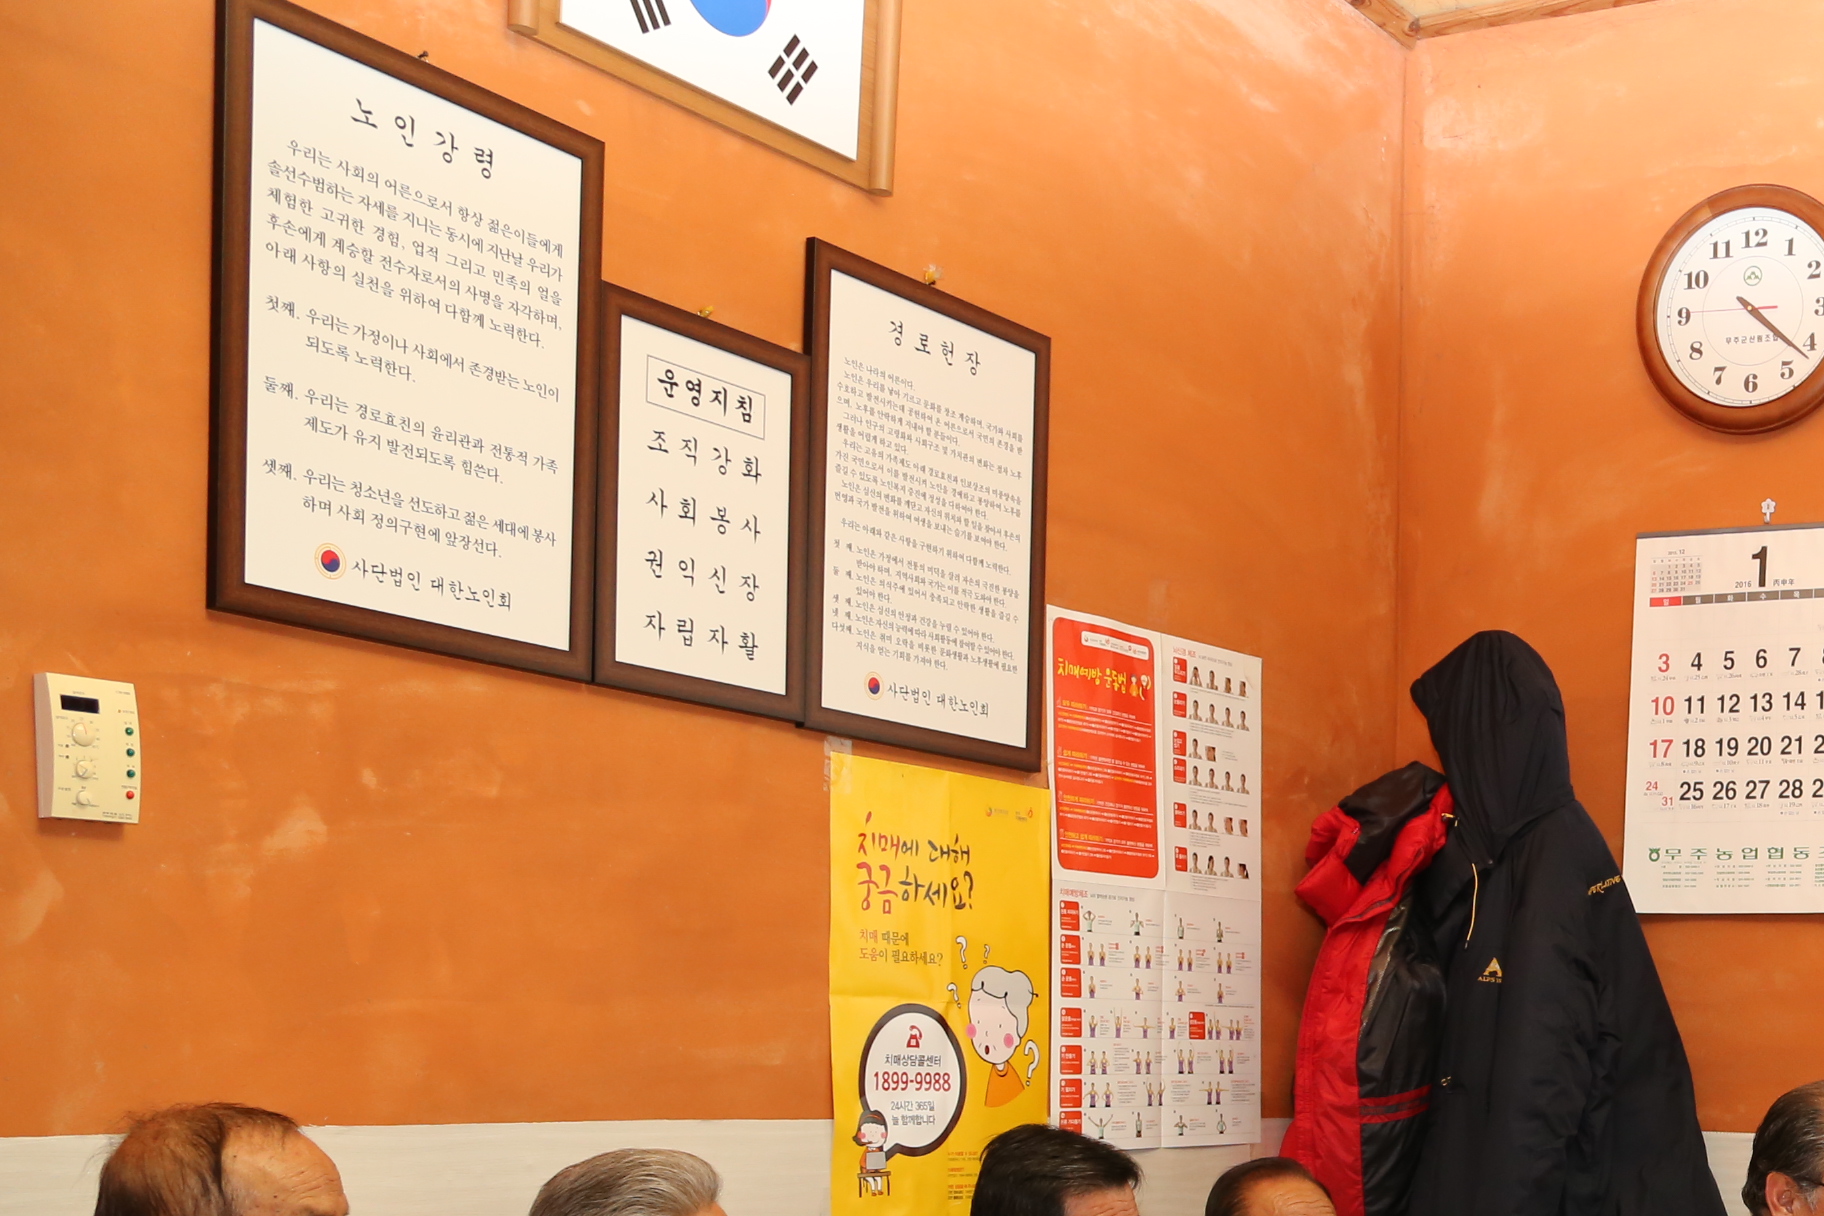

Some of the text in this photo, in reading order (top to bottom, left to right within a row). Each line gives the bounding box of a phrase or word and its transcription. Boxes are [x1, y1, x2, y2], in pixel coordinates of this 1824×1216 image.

[287, 139, 563, 259] 우리는 사회의 어른으로서 항상 젊은이들에게
[267, 159, 563, 282] 솔선수범하는 자세를 지니는 동시에 지난날 우리가
[267, 187, 562, 306] 체험한 고귀한 경험, 업적 그리고 민족의 얼을
[1709, 240, 1733, 259] 11
[1741, 228, 1768, 248] 12
[1784, 238, 1796, 256] 1
[266, 213, 561, 330] 후손에게 계승할 전수자로서의 사명을 자각하며,
[1684, 270, 1709, 290] 10
[1807, 260, 1821, 279] 2
[265, 241, 544, 349] 아래 사항의 실천을 위하여 다함께 노력한다.
[1678, 307, 1691, 326] 9
[265, 295, 559, 403] 첫째. 우리는 가정이나 사회에서 존경받는 노인이
[1689, 341, 1703, 360] 8
[1803, 332, 1817, 351] 4
[305, 335, 415, 382] 되도록 노력한다.
[1780, 360, 1794, 379] 5
[1712, 366, 1726, 385] 7
[1744, 374, 1758, 393] 6
[657, 368, 753, 423] 운영지침
[263, 375, 298, 400] 둘째.
[304, 388, 349, 414] 우리는
[355, 403, 425, 437] 경로효친의
[490, 443, 527, 466] 전통적
[533, 455, 558, 474] 가족
[304, 415, 503, 484] 제도가 유지 발전되도록 힘쓴다.
[647, 430, 762, 485] 조직강화
[262, 458, 556, 547] 셋째. 우리는 청소년을 선도하고 젊은 세대에 봉사
[645, 488, 761, 544] 사회봉사
[302, 495, 501, 558] 하며 사회 정의구현에 앞장선다.
[644, 548, 760, 602] 권익신장
[1751, 546, 1768, 587] 1
[351, 558, 511, 611] 사단법인 대한노인회
[643, 610, 759, 661] 자립자활
[1658, 653, 1669, 672] 3
[1691, 652, 1702, 671] 4
[1724, 651, 1734, 670] 5
[1756, 649, 1767, 668] 6
[1789, 648, 1801, 666] 7
[887, 681, 989, 718] 사단법인 대한노인회
[1651, 696, 1674, 715] 10
[1684, 696, 1704, 714] 11
[1717, 694, 1740, 713] 12
[1750, 692, 1772, 712] 13
[1783, 691, 1806, 711] 14
[1650, 739, 1673, 758] 17
[1683, 738, 1705, 757] 18
[1716, 737, 1738, 756] 19
[1747, 736, 1771, 756] 20
[1780, 736, 1802, 755] 21
[1646, 781, 1658, 790] 24
[1680, 782, 1703, 801] 25
[1713, 781, 1736, 800] 26
[1745, 780, 1770, 799] 27
[1779, 779, 1803, 798] 28
[1662, 797, 1673, 806] 31
[858, 811, 970, 866] 치매에 대해
[856, 862, 974, 915] 궁금하세요?
[859, 929, 878, 943] 치매
[859, 947, 888, 962] 도움이
[884, 1053, 942, 1068] 치매상담콜센터
[873, 1071, 951, 1093] 1899-9988
[890, 1100, 935, 1112] 24시간 365일
